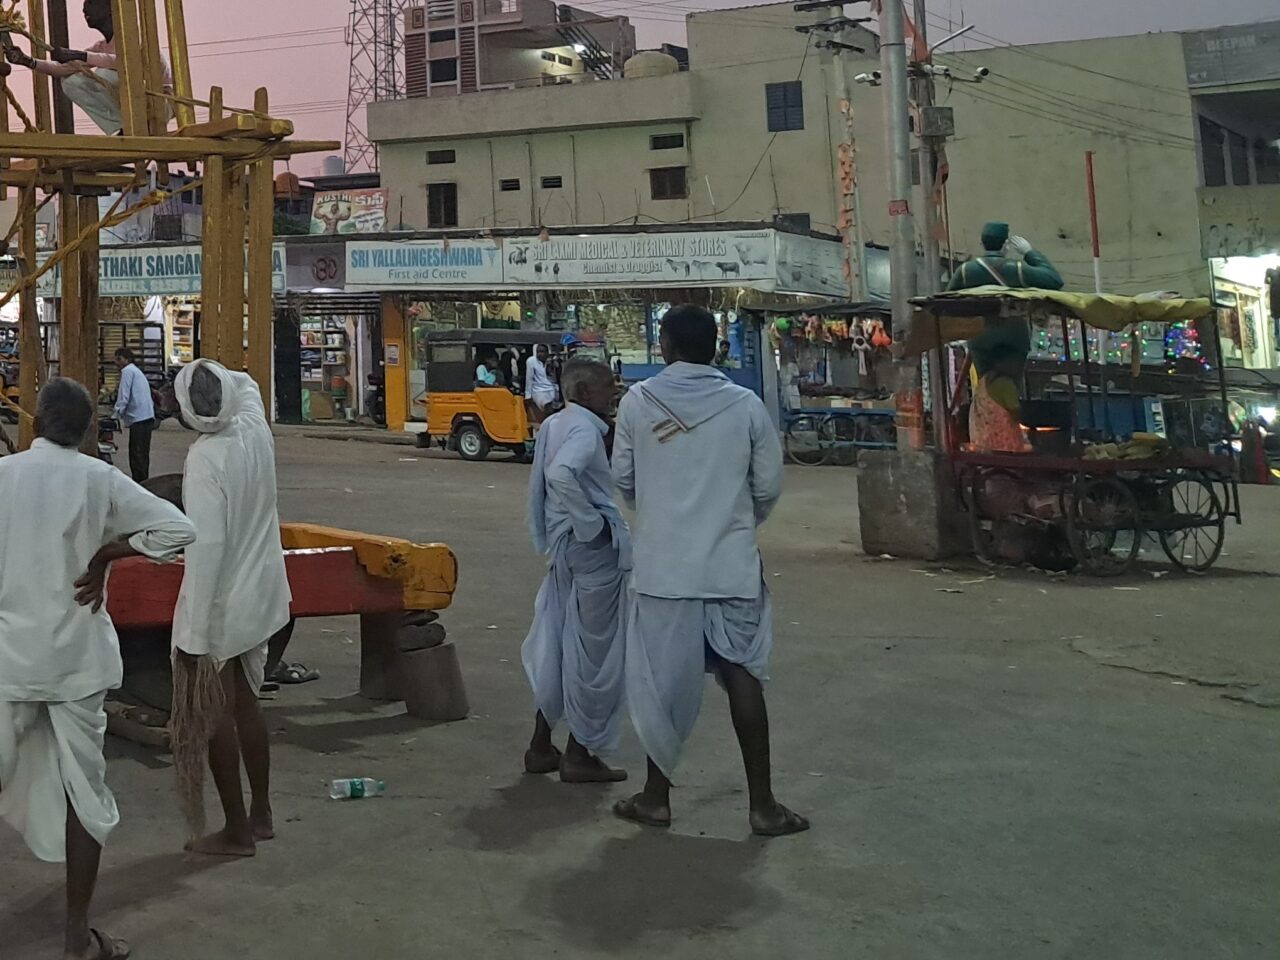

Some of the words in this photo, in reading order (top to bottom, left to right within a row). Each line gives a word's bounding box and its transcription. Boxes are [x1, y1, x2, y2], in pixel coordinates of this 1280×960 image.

[316, 193, 352, 205] KUSTHI
[531, 242, 548, 260] SRI
[579, 240, 619, 260] MEDICAL
[629, 240, 685, 259] VETERINARY
[690, 239, 727, 258] STORES
[351, 249, 369, 268] SRI
[372, 246, 483, 269] YALLALINGESHWARA
[389, 270, 410, 279] First
[412, 269, 429, 280] aid
[431, 269, 468, 280] Centre
[626, 261, 663, 275] Druggist
